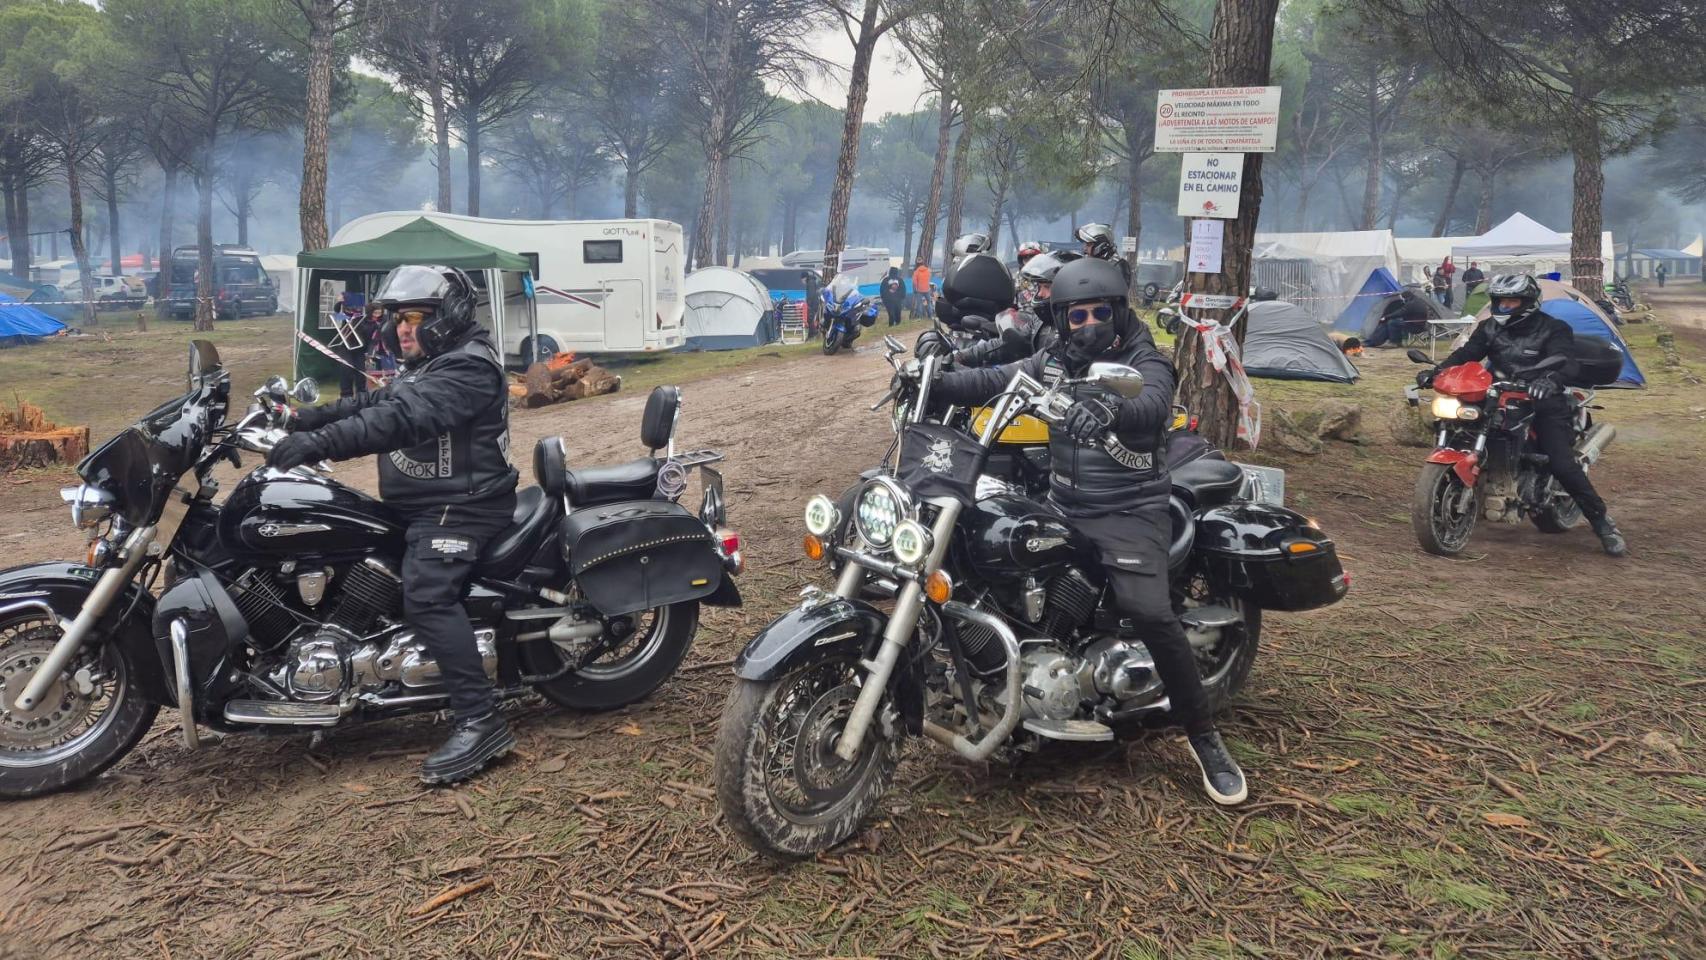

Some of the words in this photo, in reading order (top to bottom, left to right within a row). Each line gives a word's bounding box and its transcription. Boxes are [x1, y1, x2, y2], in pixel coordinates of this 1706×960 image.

[1206, 100, 1232, 108] MÁXIMA
[1162, 107, 1171, 115] 20
[1218, 118, 1240, 126] MOTOS
[1207, 158, 1219, 167] NO
[1187, 170, 1237, 180] ESTACIONAR
[1183, 183, 1194, 191] EN
[1195, 183, 1205, 192] EL
[1206, 183, 1239, 193] CAMINO
